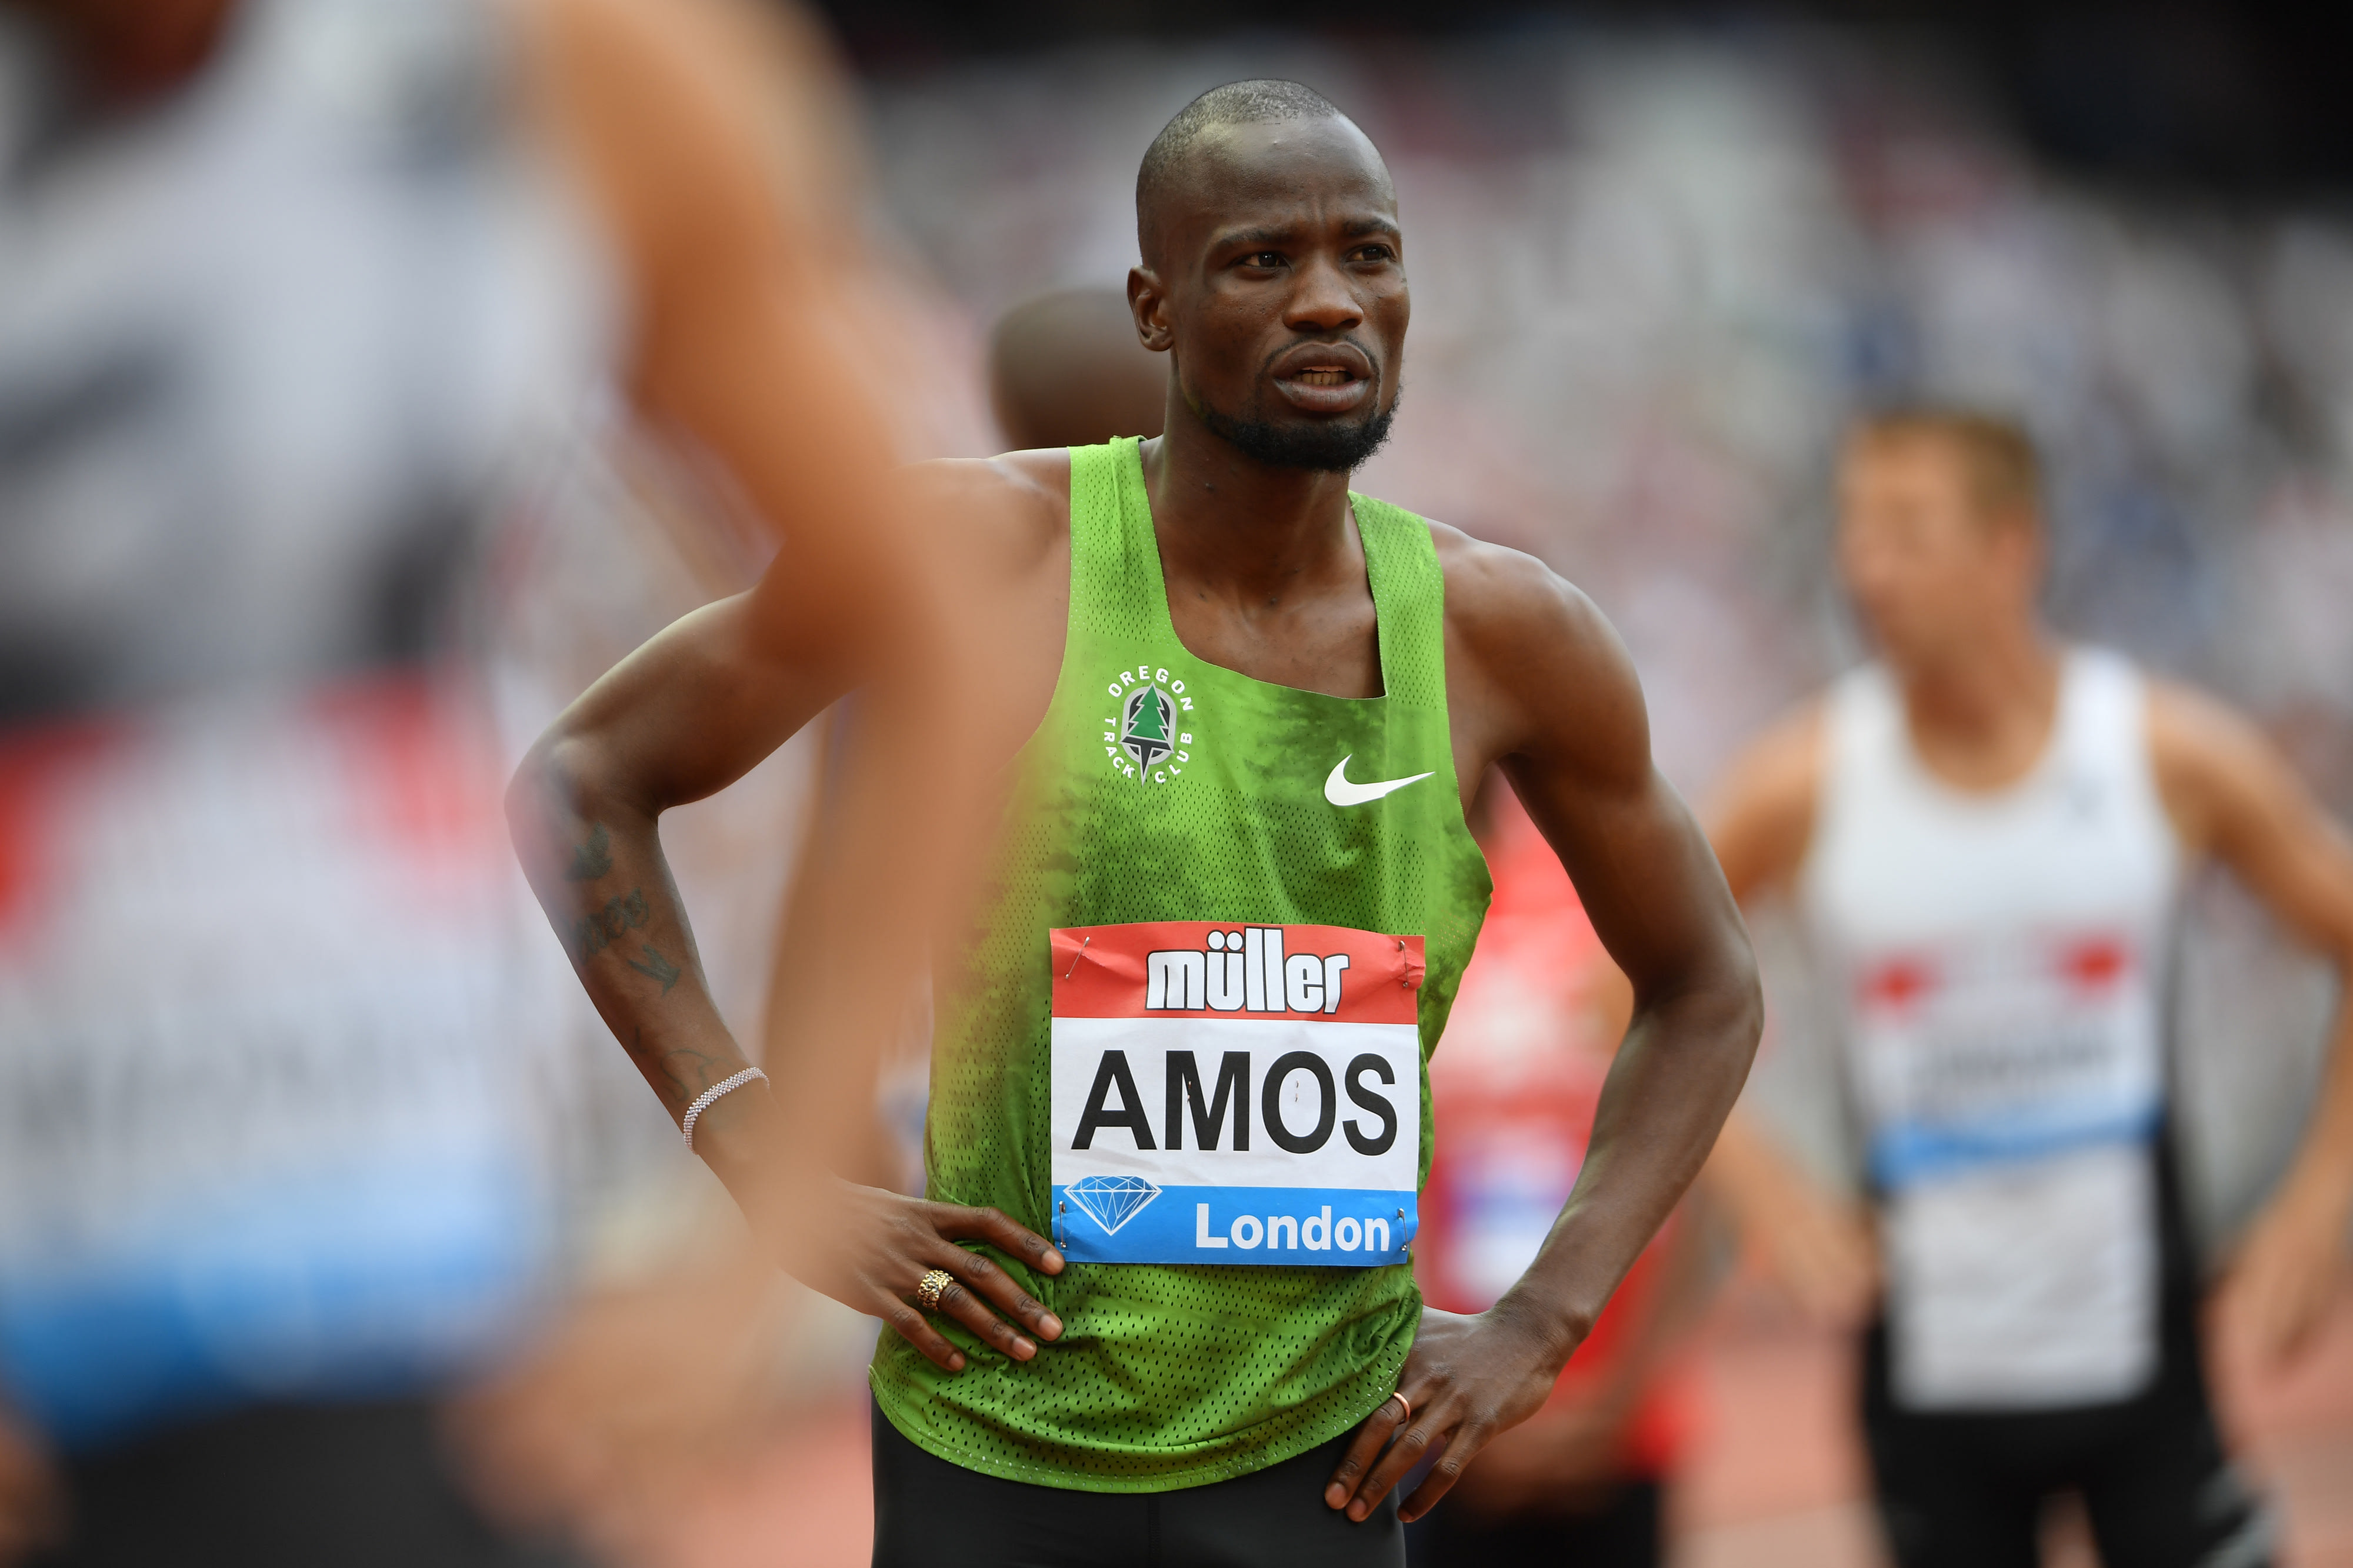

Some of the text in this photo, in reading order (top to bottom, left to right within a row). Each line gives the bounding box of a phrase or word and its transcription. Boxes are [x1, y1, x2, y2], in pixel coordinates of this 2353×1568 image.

[1108, 665, 1193, 710] OREGON
[1105, 717, 1192, 783] TRACK CLUB
[1145, 927, 1350, 1015] müller
[1071, 1049, 1398, 1156] AMOS
[1195, 1203, 1389, 1252] London
